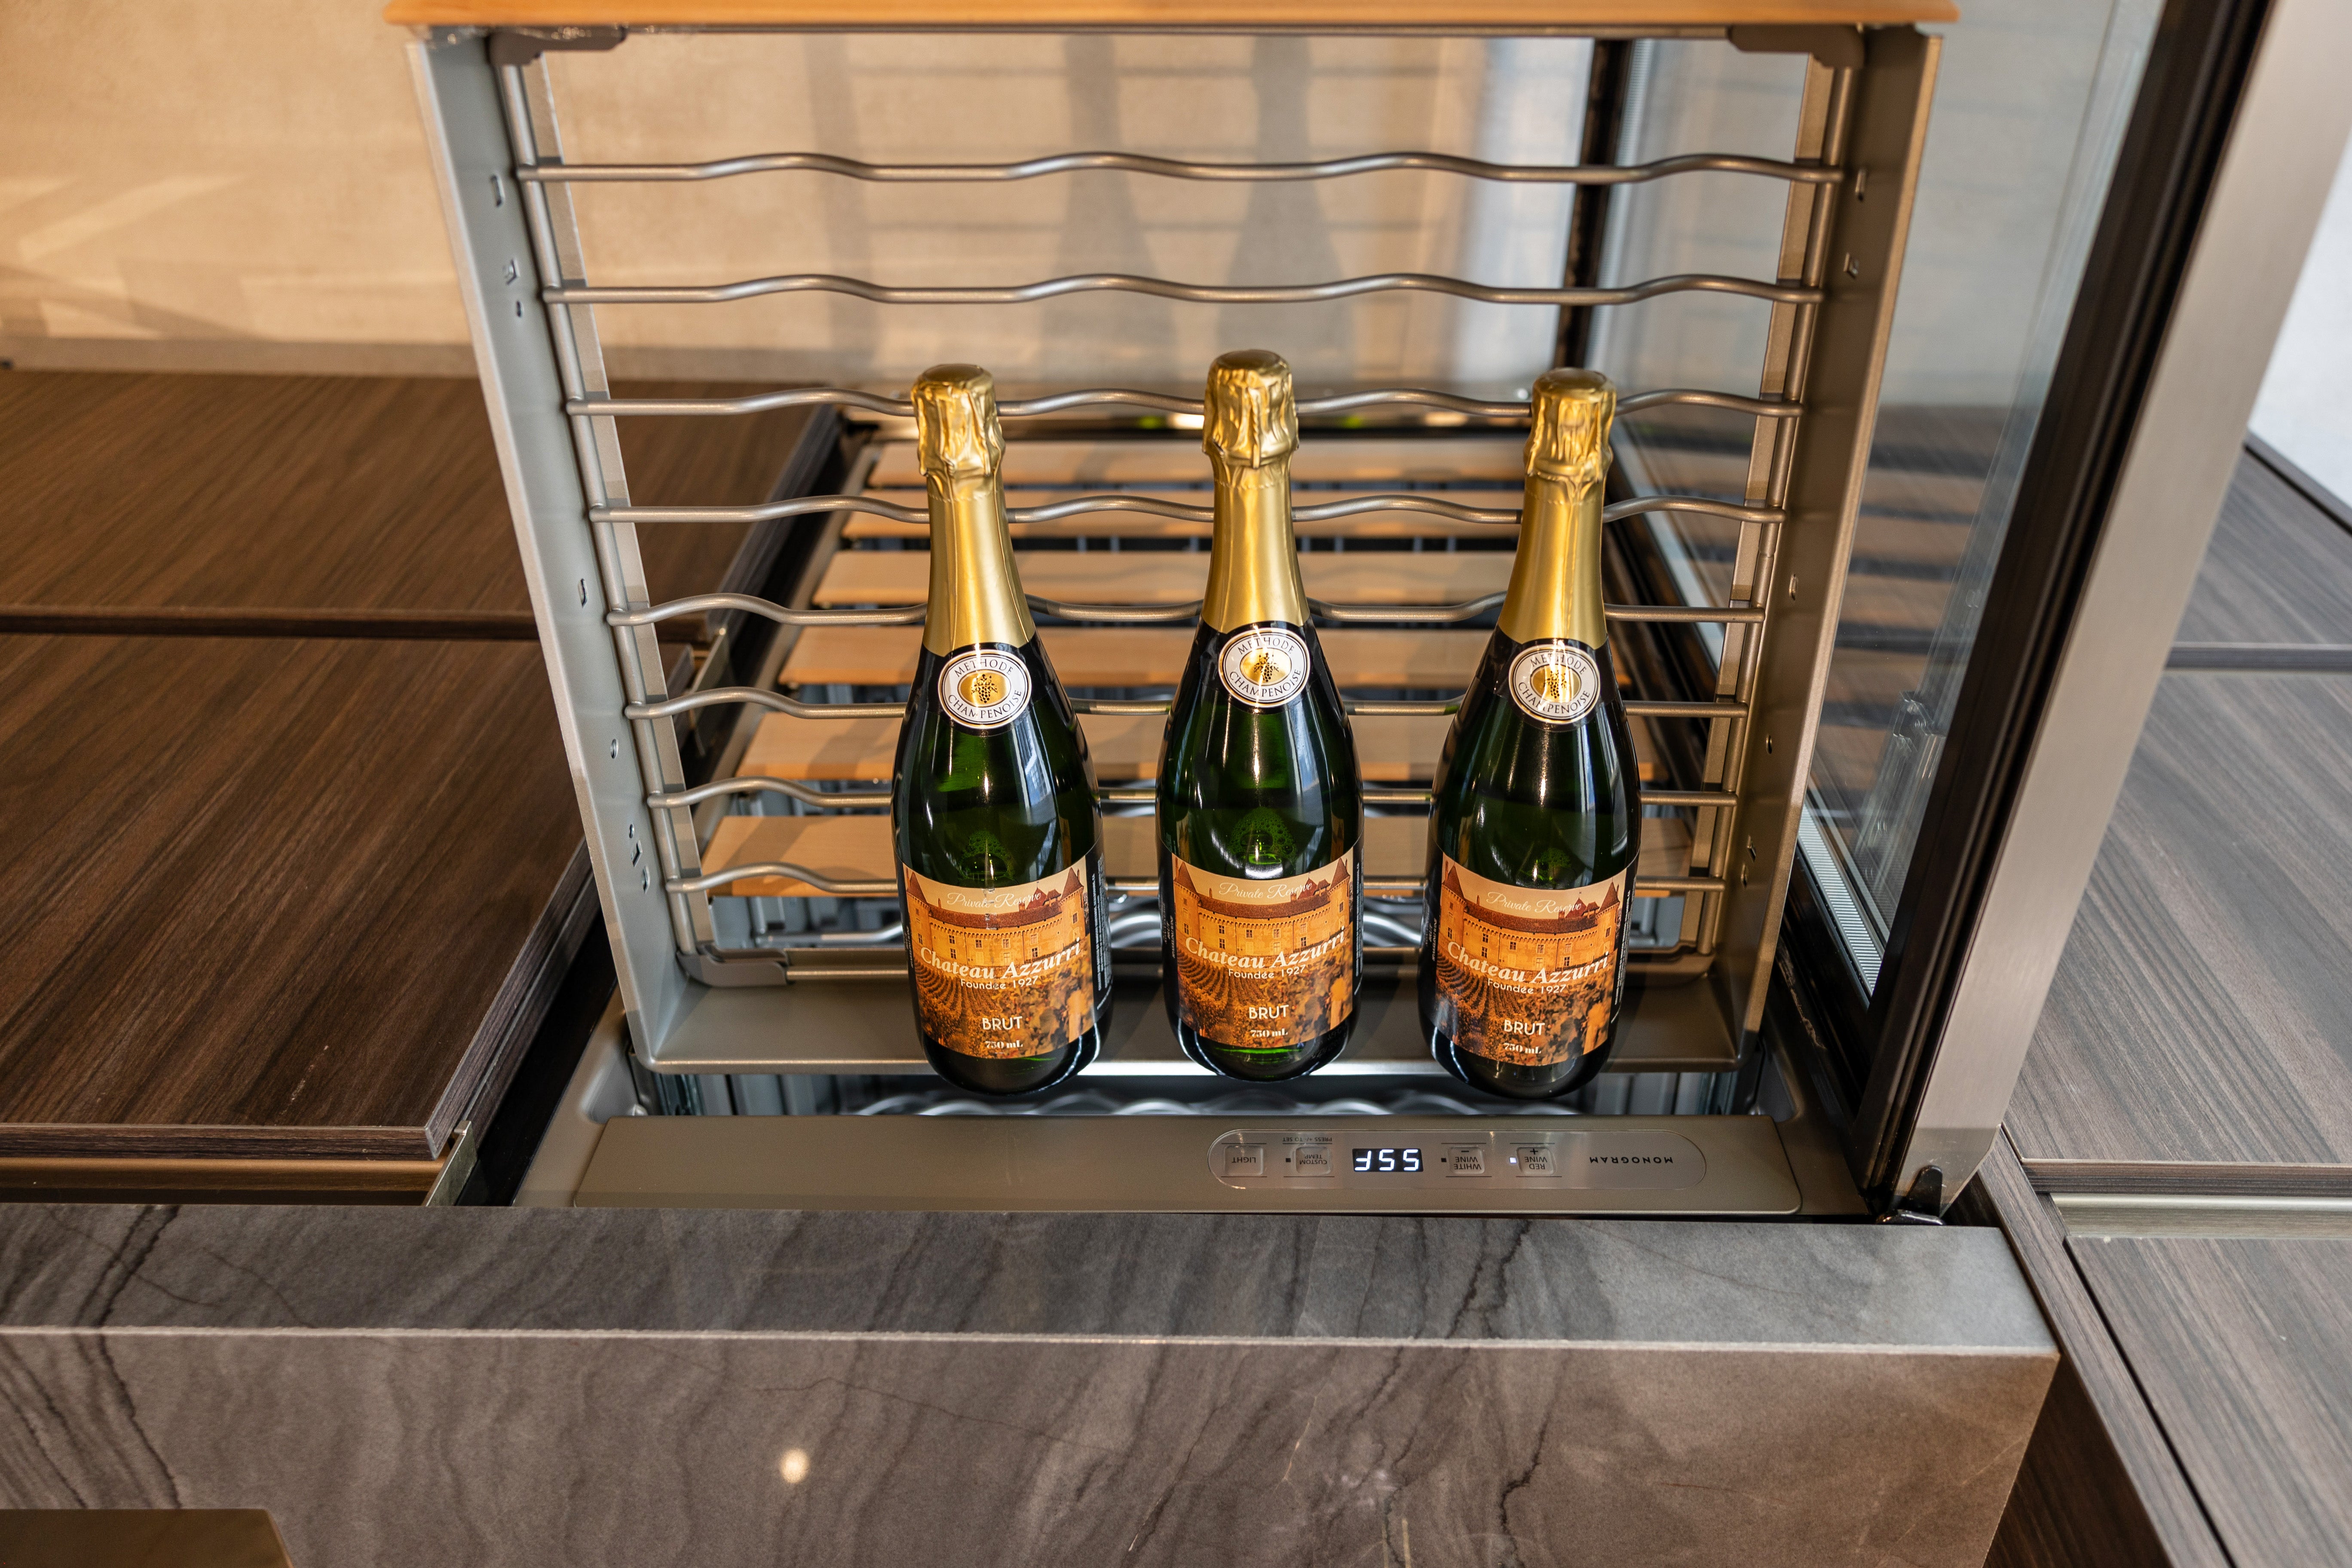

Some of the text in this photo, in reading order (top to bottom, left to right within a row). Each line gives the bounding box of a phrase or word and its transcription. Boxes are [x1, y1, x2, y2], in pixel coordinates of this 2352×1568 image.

[1237, 637, 1295, 655] METHODE
[955, 658, 1014, 677] METHODE
[1230, 669, 1301, 697] CHAMPENOISE
[948, 690, 1022, 719] CHAMPENOISE
[1219, 881, 1312, 899] Private Reserve
[947, 891, 1041, 908] Private Reserve
[1486, 891, 1582, 913] Private Reserve
[1185, 926, 1345, 968] Chateau Azzurri
[921, 947, 994, 979] Chateau
[1001, 937, 1081, 979] Azzurri
[1448, 941, 1609, 984] Chateau Azzurri
[1228, 964, 1306, 980] Foundée 1927
[1013, 975, 1038, 988] 1927
[1488, 978, 1567, 995] Foundée 1927
[1249, 1004, 1289, 1020] BRUT
[982, 1016, 1023, 1031] BRUT
[1504, 1020, 1545, 1035] BRUT
[1272, 1029, 1288, 1037] mL
[985, 1040, 1023, 1049] 750 mL
[1504, 1043, 1542, 1054] 750 mL
